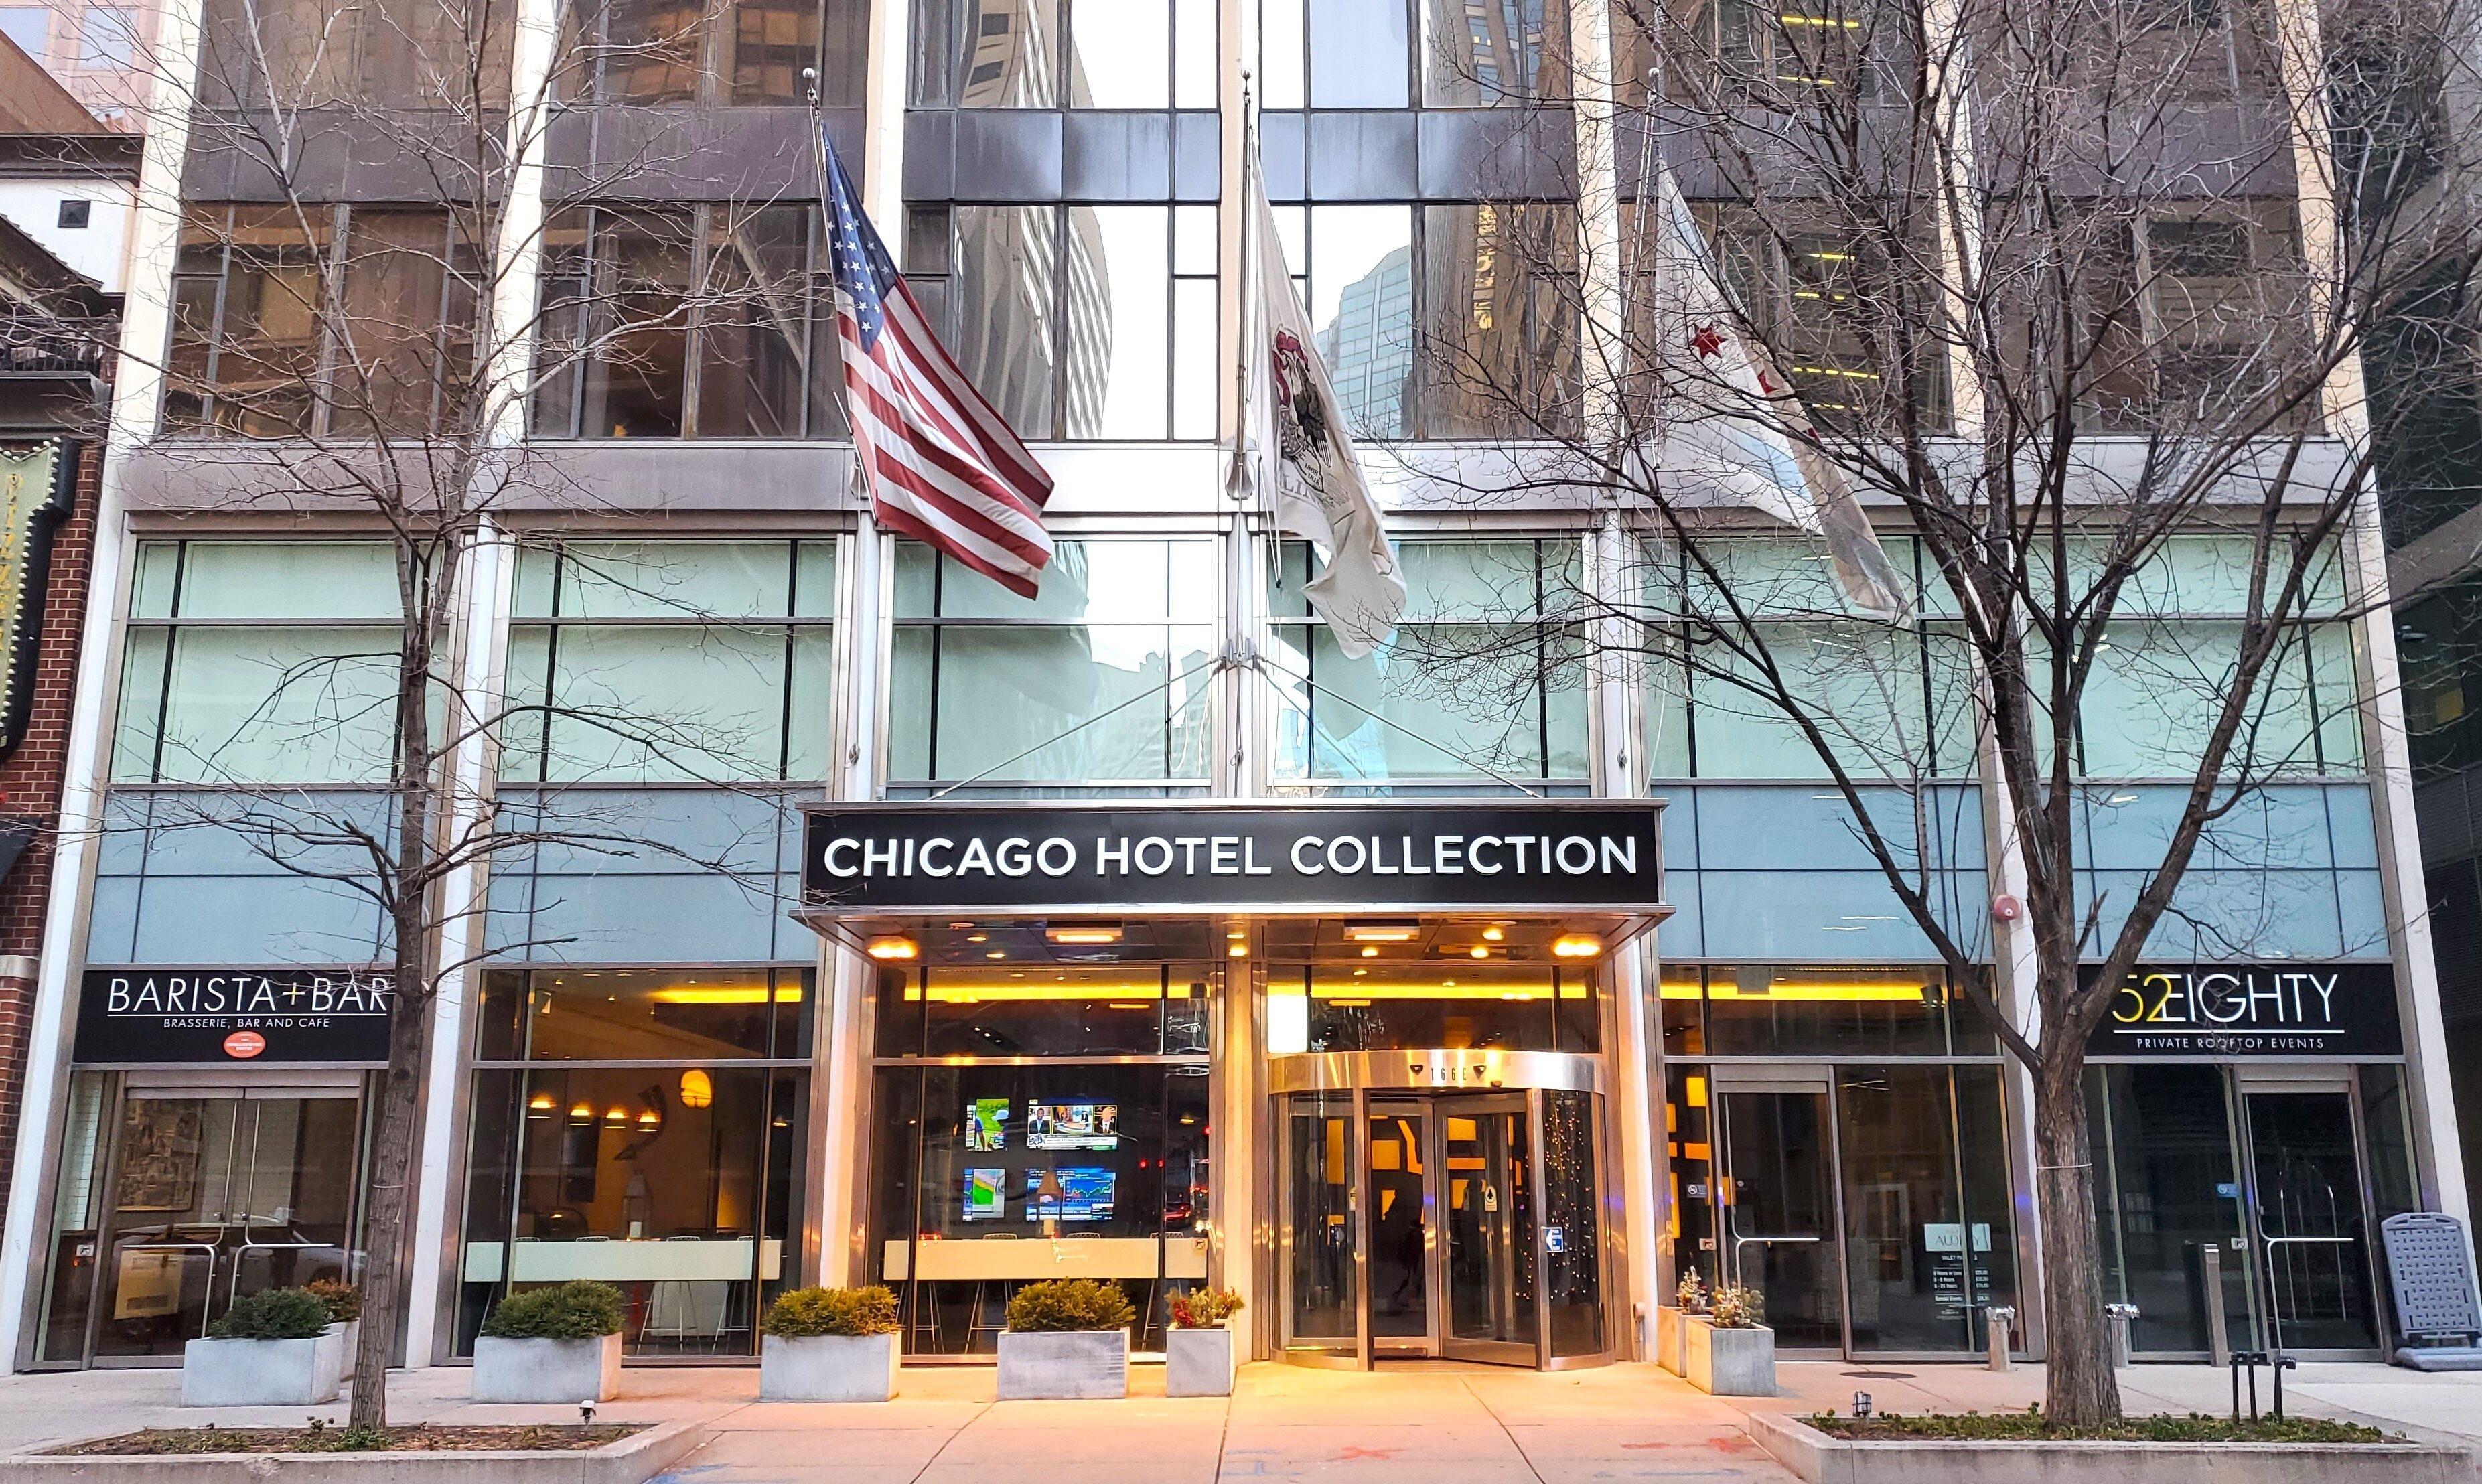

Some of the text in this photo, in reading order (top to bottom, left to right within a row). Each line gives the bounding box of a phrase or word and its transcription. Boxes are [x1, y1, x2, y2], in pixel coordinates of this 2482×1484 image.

[824, 835, 1637, 877] CHICAGO HOTEL COLLECTION
[163, 1018, 330, 1029] BRASSERIE, BAR AND CAFE
[2136, 1037, 2324, 1049] PRIVATE ROOFTOP EVENTS
